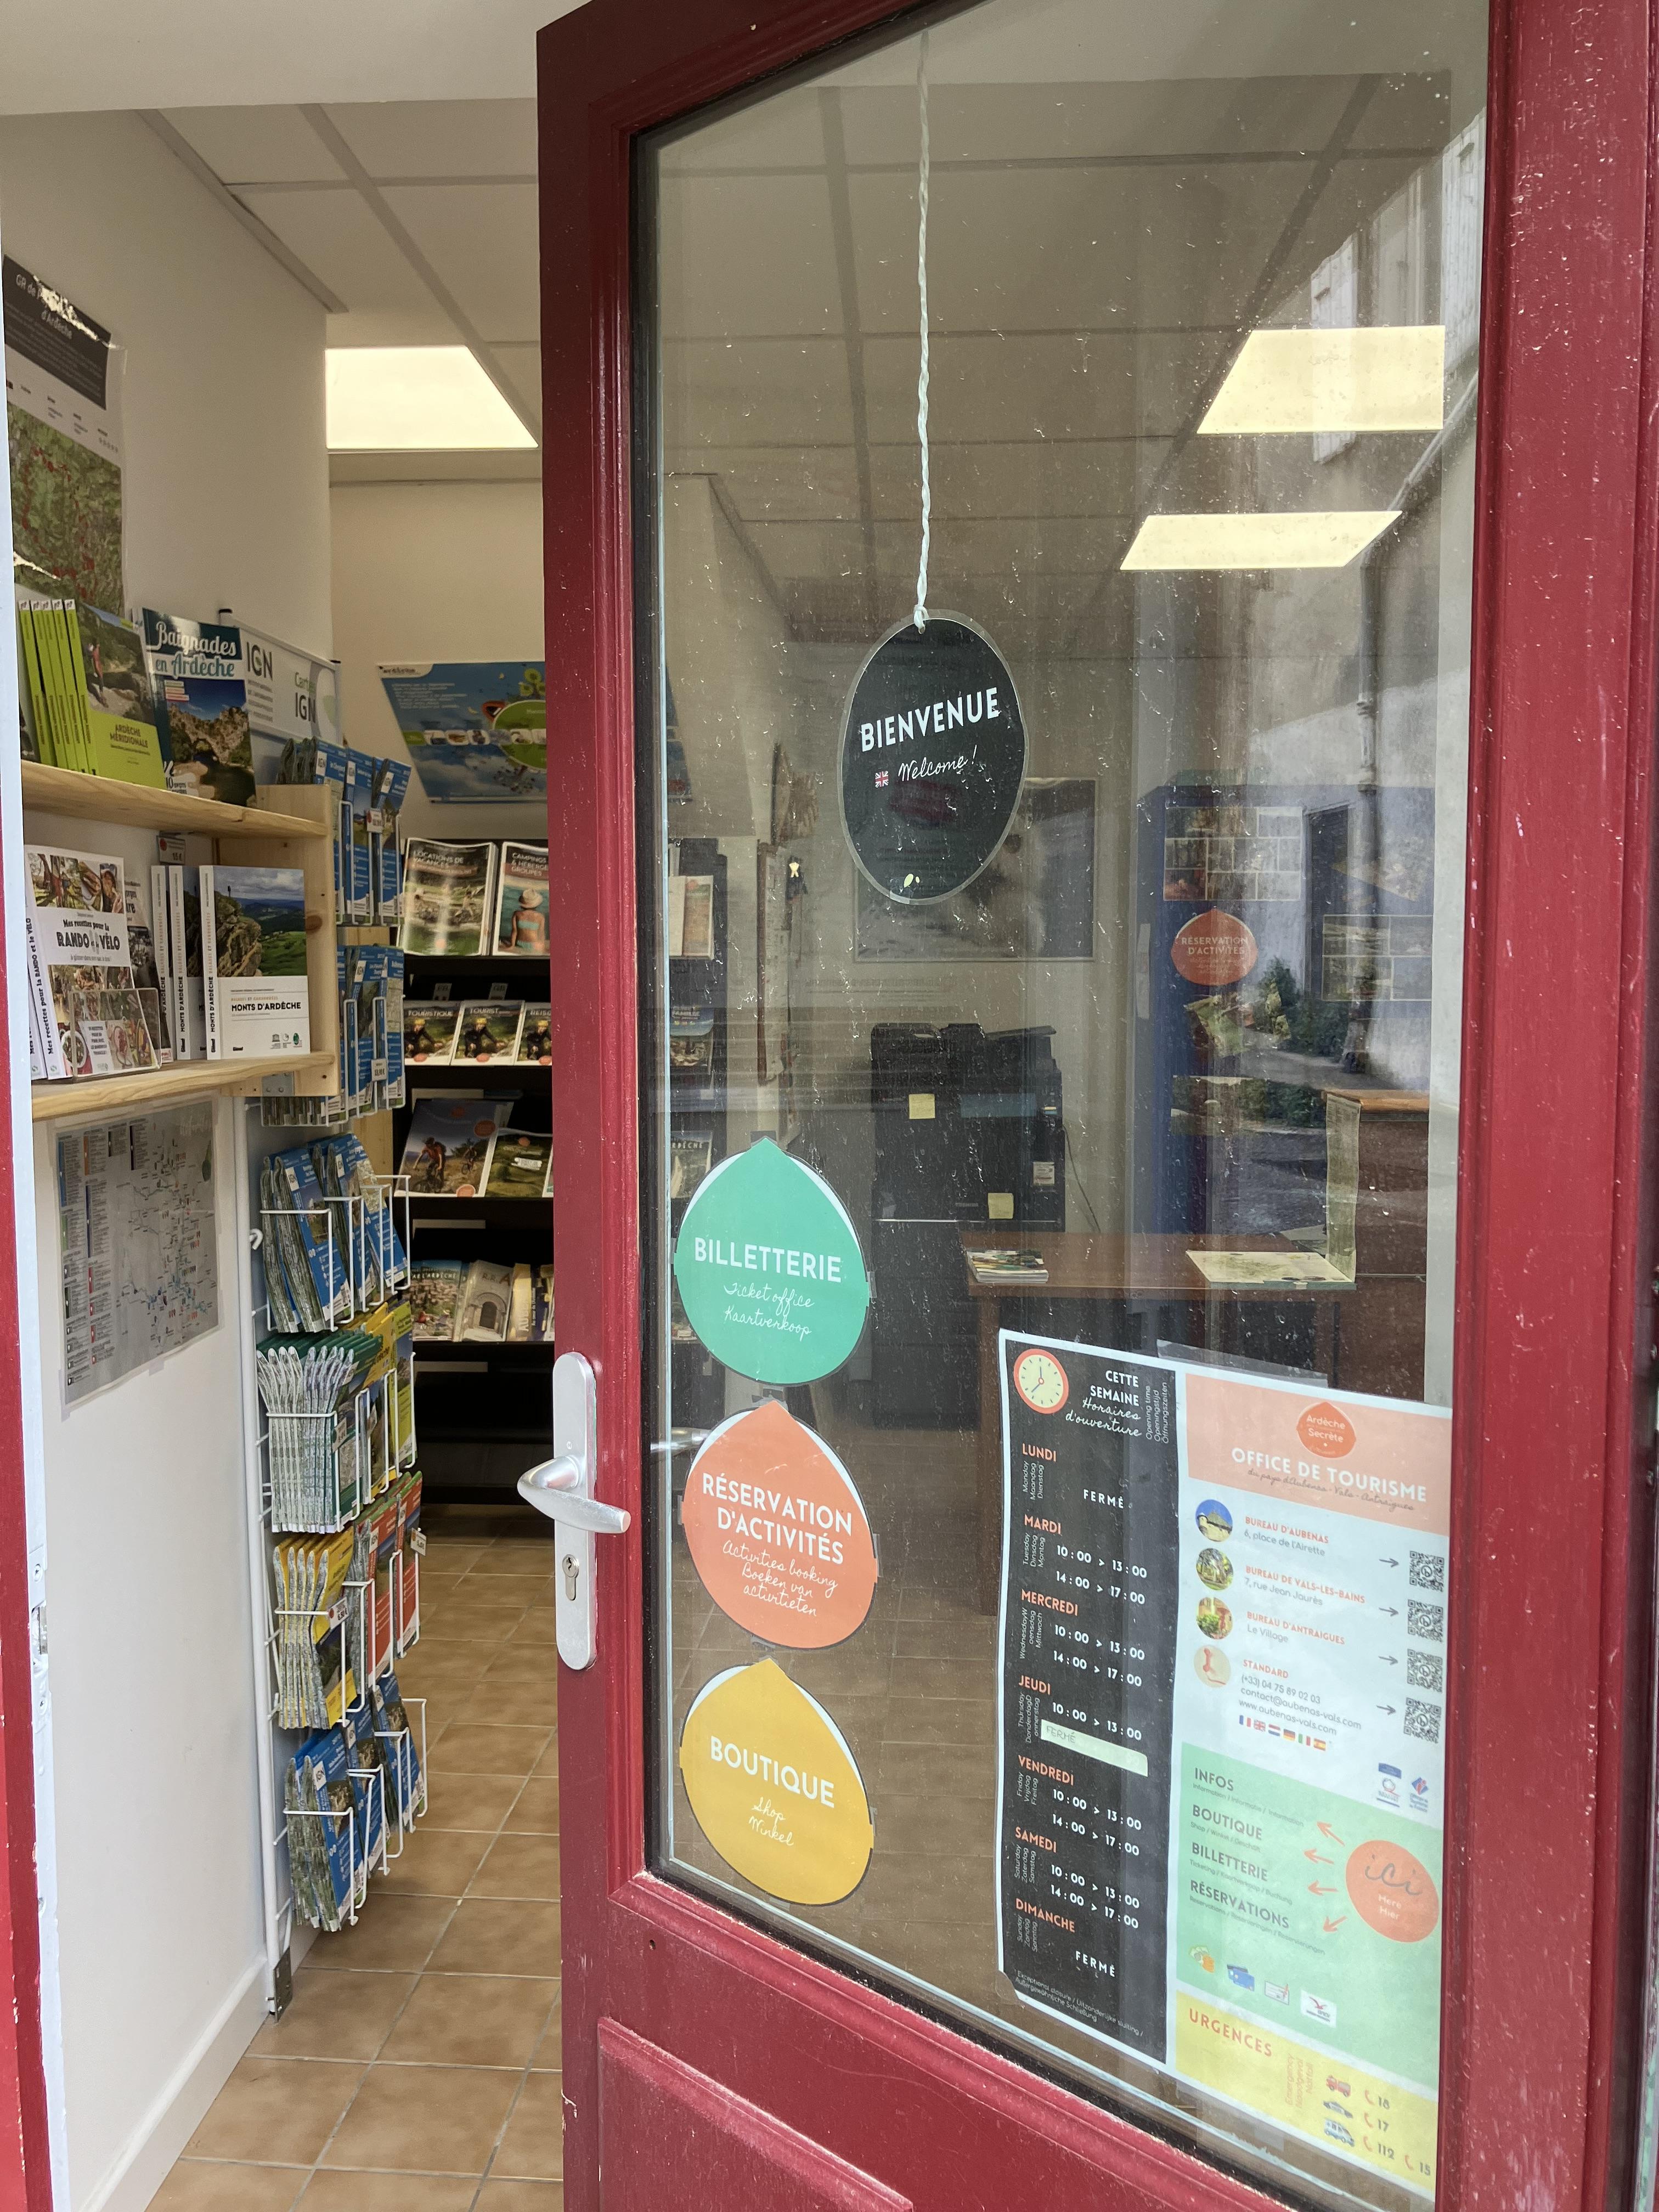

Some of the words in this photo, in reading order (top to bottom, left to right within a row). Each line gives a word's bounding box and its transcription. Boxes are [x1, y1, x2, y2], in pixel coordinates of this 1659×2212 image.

[146, 621, 236, 656] Baignades
[155, 659, 167, 673] en
[171, 652, 235, 679] Ardèche
[247, 641, 273, 681] IGN
[295, 693, 316, 723] IGN
[861, 687, 1000, 752] BIENVENUE
[898, 753, 968, 782] Welcome
[57, 932, 89, 948] RANDO
[99, 933, 120, 950] VÉLO
[33, 954, 42, 978] RANDO
[38, 989, 48, 1007] pour
[232, 1004, 256, 1012] MONTS
[258, 1001, 301, 1011] D'ARDÈCHE
[42, 1008, 52, 1039] recettes
[695, 1237, 842, 1283] BILLETTERIE
[723, 1282, 771, 1301] Ticket
[772, 1288, 815, 1317] office
[724, 1304, 812, 1341] Kaartverkoop
[1105, 1370, 1139, 1387] CETTE
[1082, 1397, 1141, 1420] Horaires
[1090, 1385, 1139, 1407] SEMAINE
[1065, 1409, 1142, 1437] d'ouverture
[1307, 1414, 1346, 1429] Ardèche
[1308, 1427, 1344, 1443] Secrète
[1022, 1443, 1056, 1462] LUNDI
[1232, 1448, 1291, 1474] OFFICE
[1299, 1462, 1320, 1480] DE
[1327, 1468, 1426, 1502] TOURISME
[703, 1472, 852, 1536] RÉSERVATION
[1084, 1488, 1124, 1509] FERMÉ
[718, 1507, 843, 1564] D'ACTIVITÉS
[1024, 1514, 1062, 1535] MARDI
[1245, 1516, 1278, 1531] BUREAU
[1281, 1525, 1329, 1544] D'AUBENAS
[1023, 1532, 1031, 1565] Tuesday
[1252, 1532, 1277, 1544] place
[1279, 1538, 1290, 1547] de
[1291, 1540, 1325, 1556] l'Airette
[723, 1540, 787, 1572] Activities
[789, 1559, 838, 1598] booking
[742, 1562, 787, 1589] Boeken
[791, 1583, 813, 1598] van
[1246, 1566, 1278, 1581] BUREAU
[1282, 1575, 1293, 1584] DE
[1295, 1578, 1365, 1604] VALS-LES-BAINS
[1253, 1581, 1268, 1590] rue
[1269, 1585, 1291, 1597] Jean
[1293, 1592, 1323, 1606] Jaurès
[743, 1585, 817, 1617] activitieten
[1021, 1589, 1079, 1616] MERCREDI
[1247, 1611, 1280, 1627] BUREAU
[1283, 1621, 1345, 1645] D'ANTRAIGUES
[1248, 1624, 1258, 1634] Le
[1260, 1627, 1289, 1643] Village
[1243, 1659, 1289, 1679] STANDARD
[1018, 1675, 1051, 1695] JEUDI
[1242, 1674, 1260, 1688] (+33)
[1262, 1680, 1272, 1690] 04
[1274, 1683, 1284, 1694] 75
[1286, 1686, 1296, 1696] 89
[1299, 1691, 1308, 1701] 02
[1311, 1695, 1321, 1704] 03
[1239, 1699, 1336, 1736] www.aubenas-vals.com
[1241, 1687, 1362, 1729] contact@aubenas-vals.com
[1046, 1725, 1076, 1743] FERMÉ
[710, 1735, 834, 1808] BOUTIQUE
[1018, 1754, 1074, 1786] VENDREDI
[1195, 1767, 1234, 1792] INFOS
[751, 1797, 786, 1824] Shop
[1193, 1804, 1262, 1841] BOUTIQUE
[748, 1816, 794, 1847] Winkel
[1015, 1826, 1057, 1853] SAMEDI
[1192, 1842, 1268, 1882] BILLETTERIE
[1365, 1854, 1423, 1896] ici
[1015, 1898, 1075, 1933] DIMANCHE
[1190, 1880, 1289, 1929] RÉSERVATIONS
[1379, 1894, 1402, 1910] Here
[1379, 1905, 1400, 1920] Hier
[1075, 1950, 1115, 1977] FERMÉ
[1189, 2007, 1272, 2058] URGENCES
[1378, 2096, 1390, 2110] 18
[1378, 2119, 1390, 2132] 17
[1378, 2143, 1395, 2160] 112
[1420, 2162, 1431, 2176] 15
